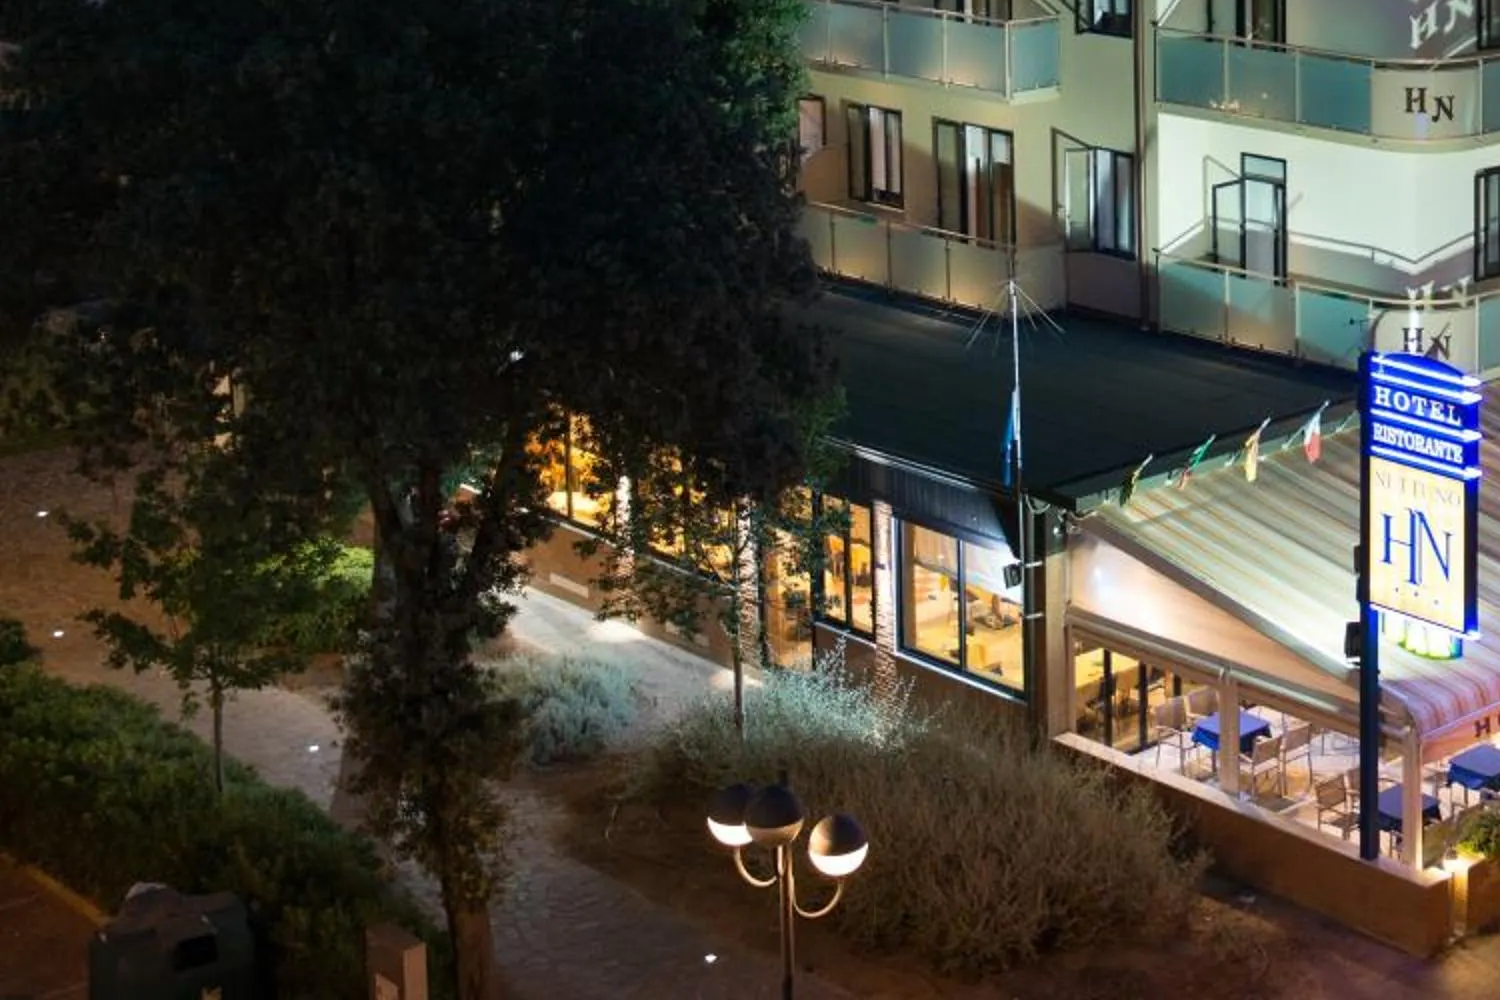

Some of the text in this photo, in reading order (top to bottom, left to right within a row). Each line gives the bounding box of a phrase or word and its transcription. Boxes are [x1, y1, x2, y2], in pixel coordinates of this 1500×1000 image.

[1404, 87, 1455, 122] HN
[1374, 385, 1462, 427] HOTEL
[1372, 421, 1464, 464] RISTORANTE
